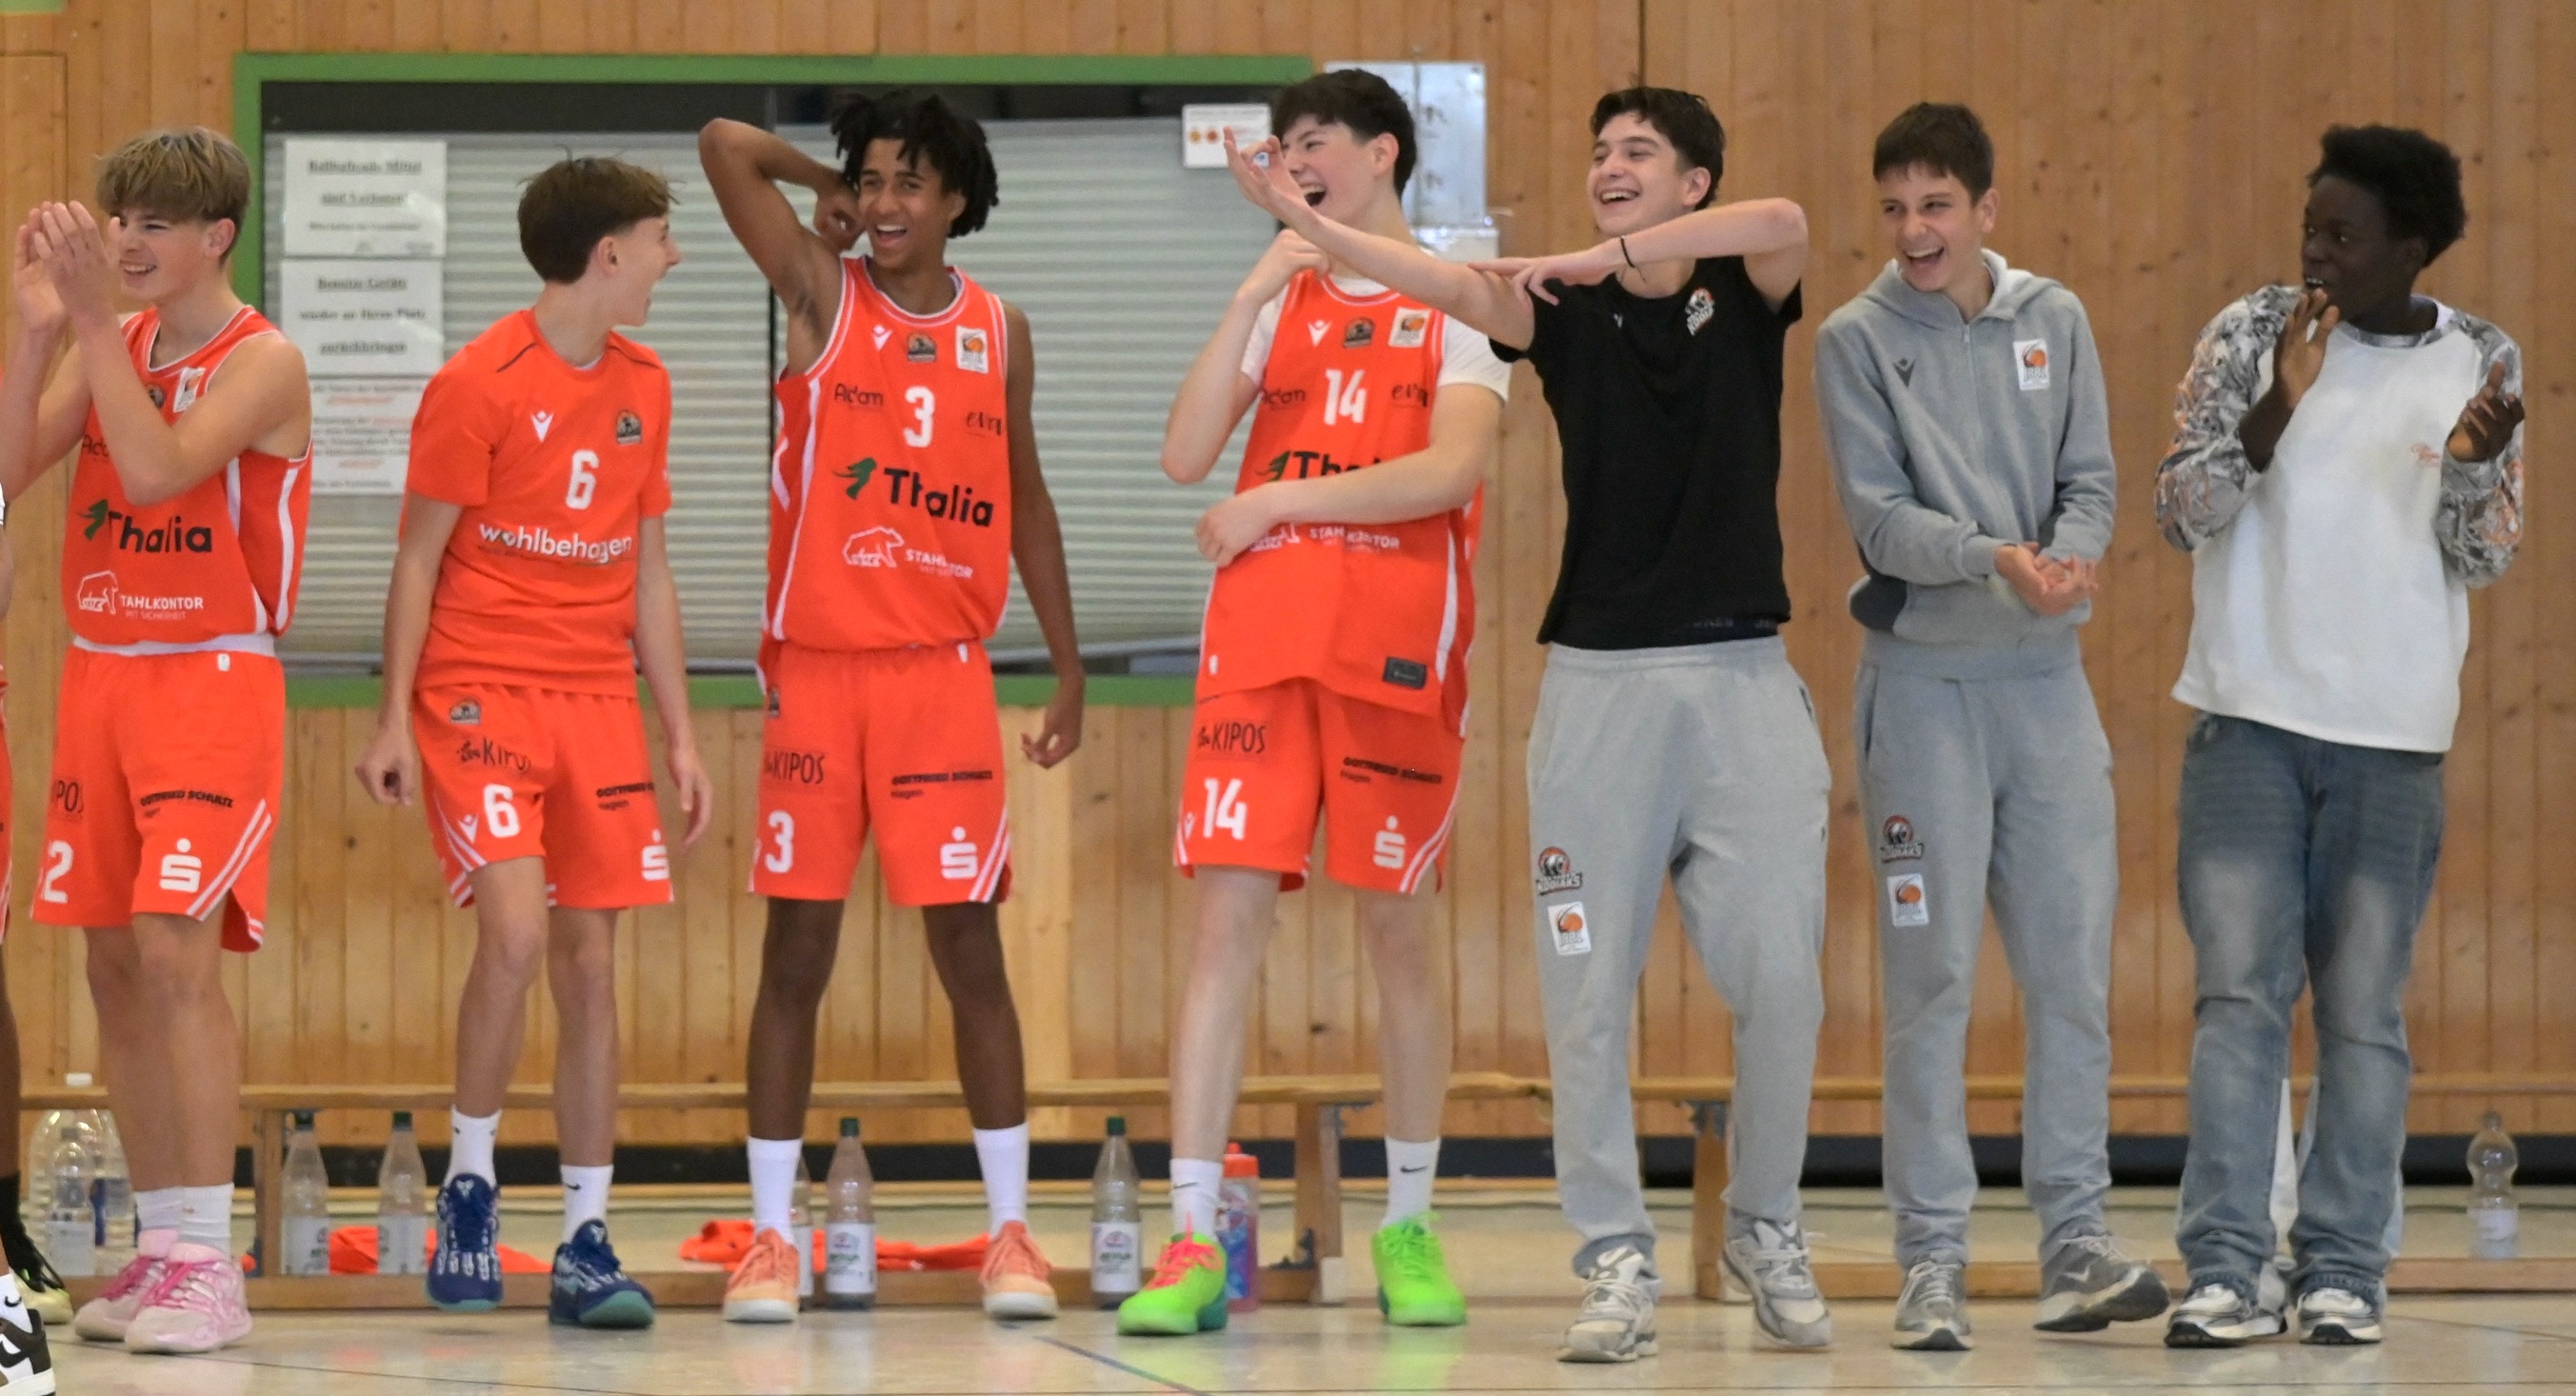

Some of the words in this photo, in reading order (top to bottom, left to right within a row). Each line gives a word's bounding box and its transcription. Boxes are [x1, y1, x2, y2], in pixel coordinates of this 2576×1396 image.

[904, 385, 935, 448] 3
[1324, 369, 1368, 426] 14
[566, 449, 599, 509] 6
[120, 594, 204, 610] TAHLKONTOR
[483, 784, 521, 839] 6
[1203, 777, 1247, 840] 14
[765, 809, 794, 873] 3
[42, 840, 73, 904] 2
